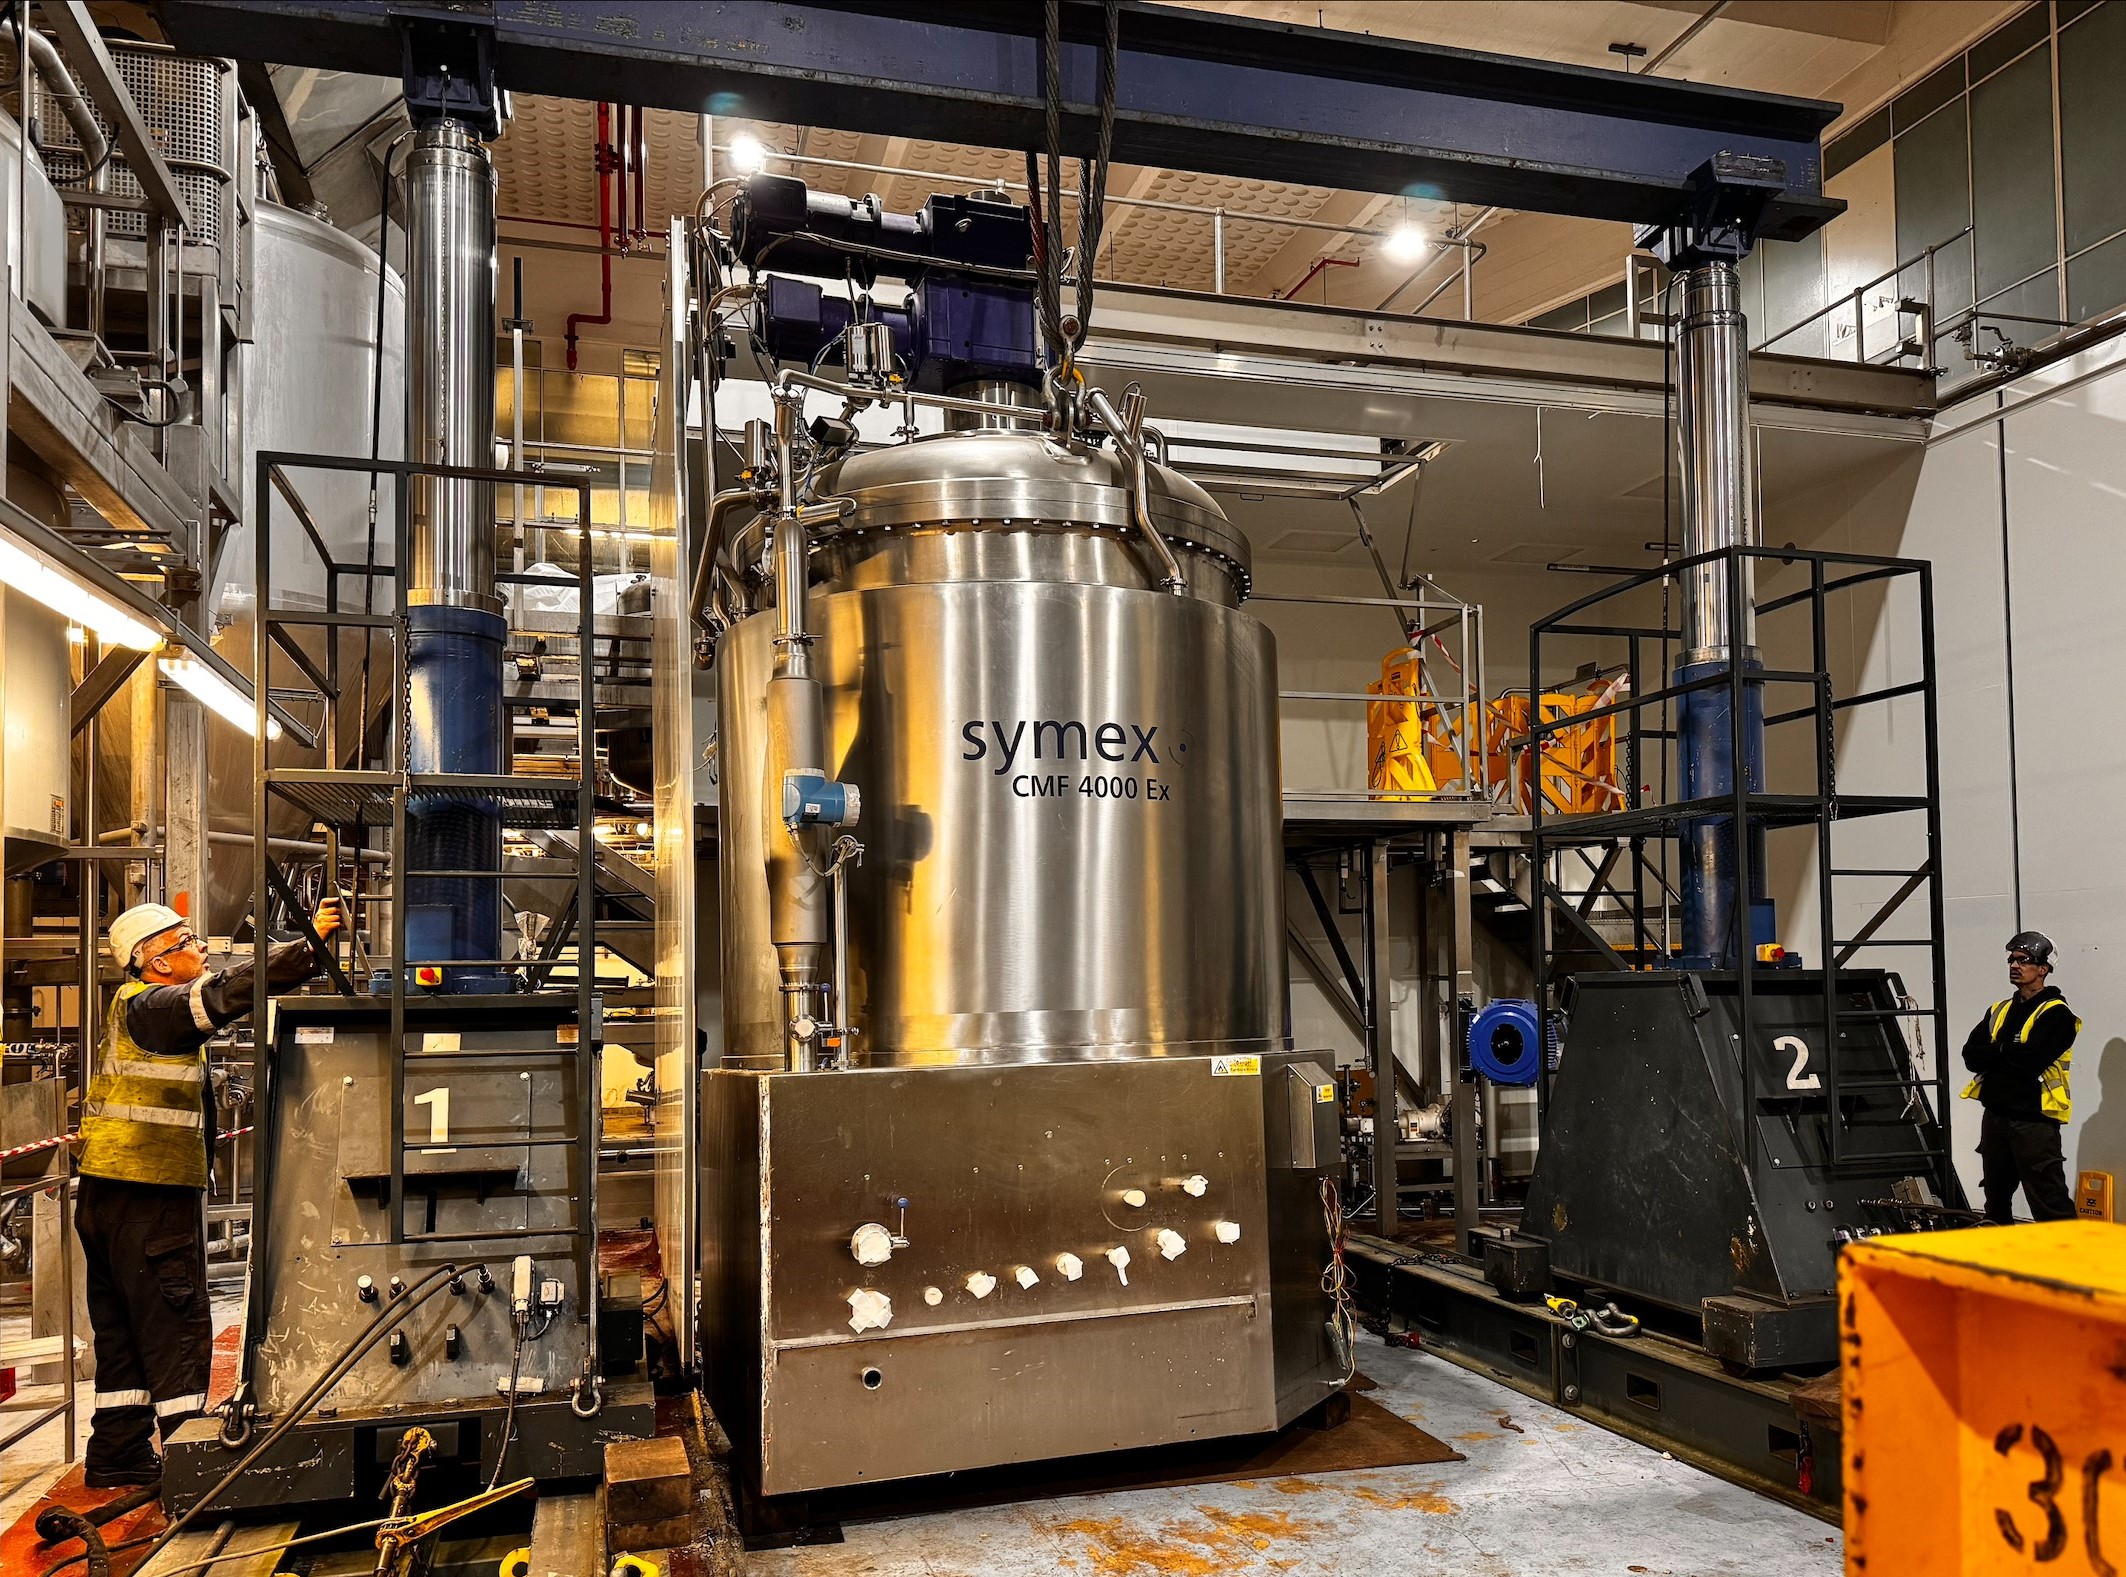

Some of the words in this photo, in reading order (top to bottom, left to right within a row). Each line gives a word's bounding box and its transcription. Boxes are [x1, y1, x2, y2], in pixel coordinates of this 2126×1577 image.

[962, 720, 1160, 775] symex
[1012, 775, 1069, 797] CMF
[1078, 775, 1138, 798] 4000
[1146, 778, 1171, 801] Ex
[1773, 1035, 1822, 1090] 2
[414, 1087, 457, 1155] 1
